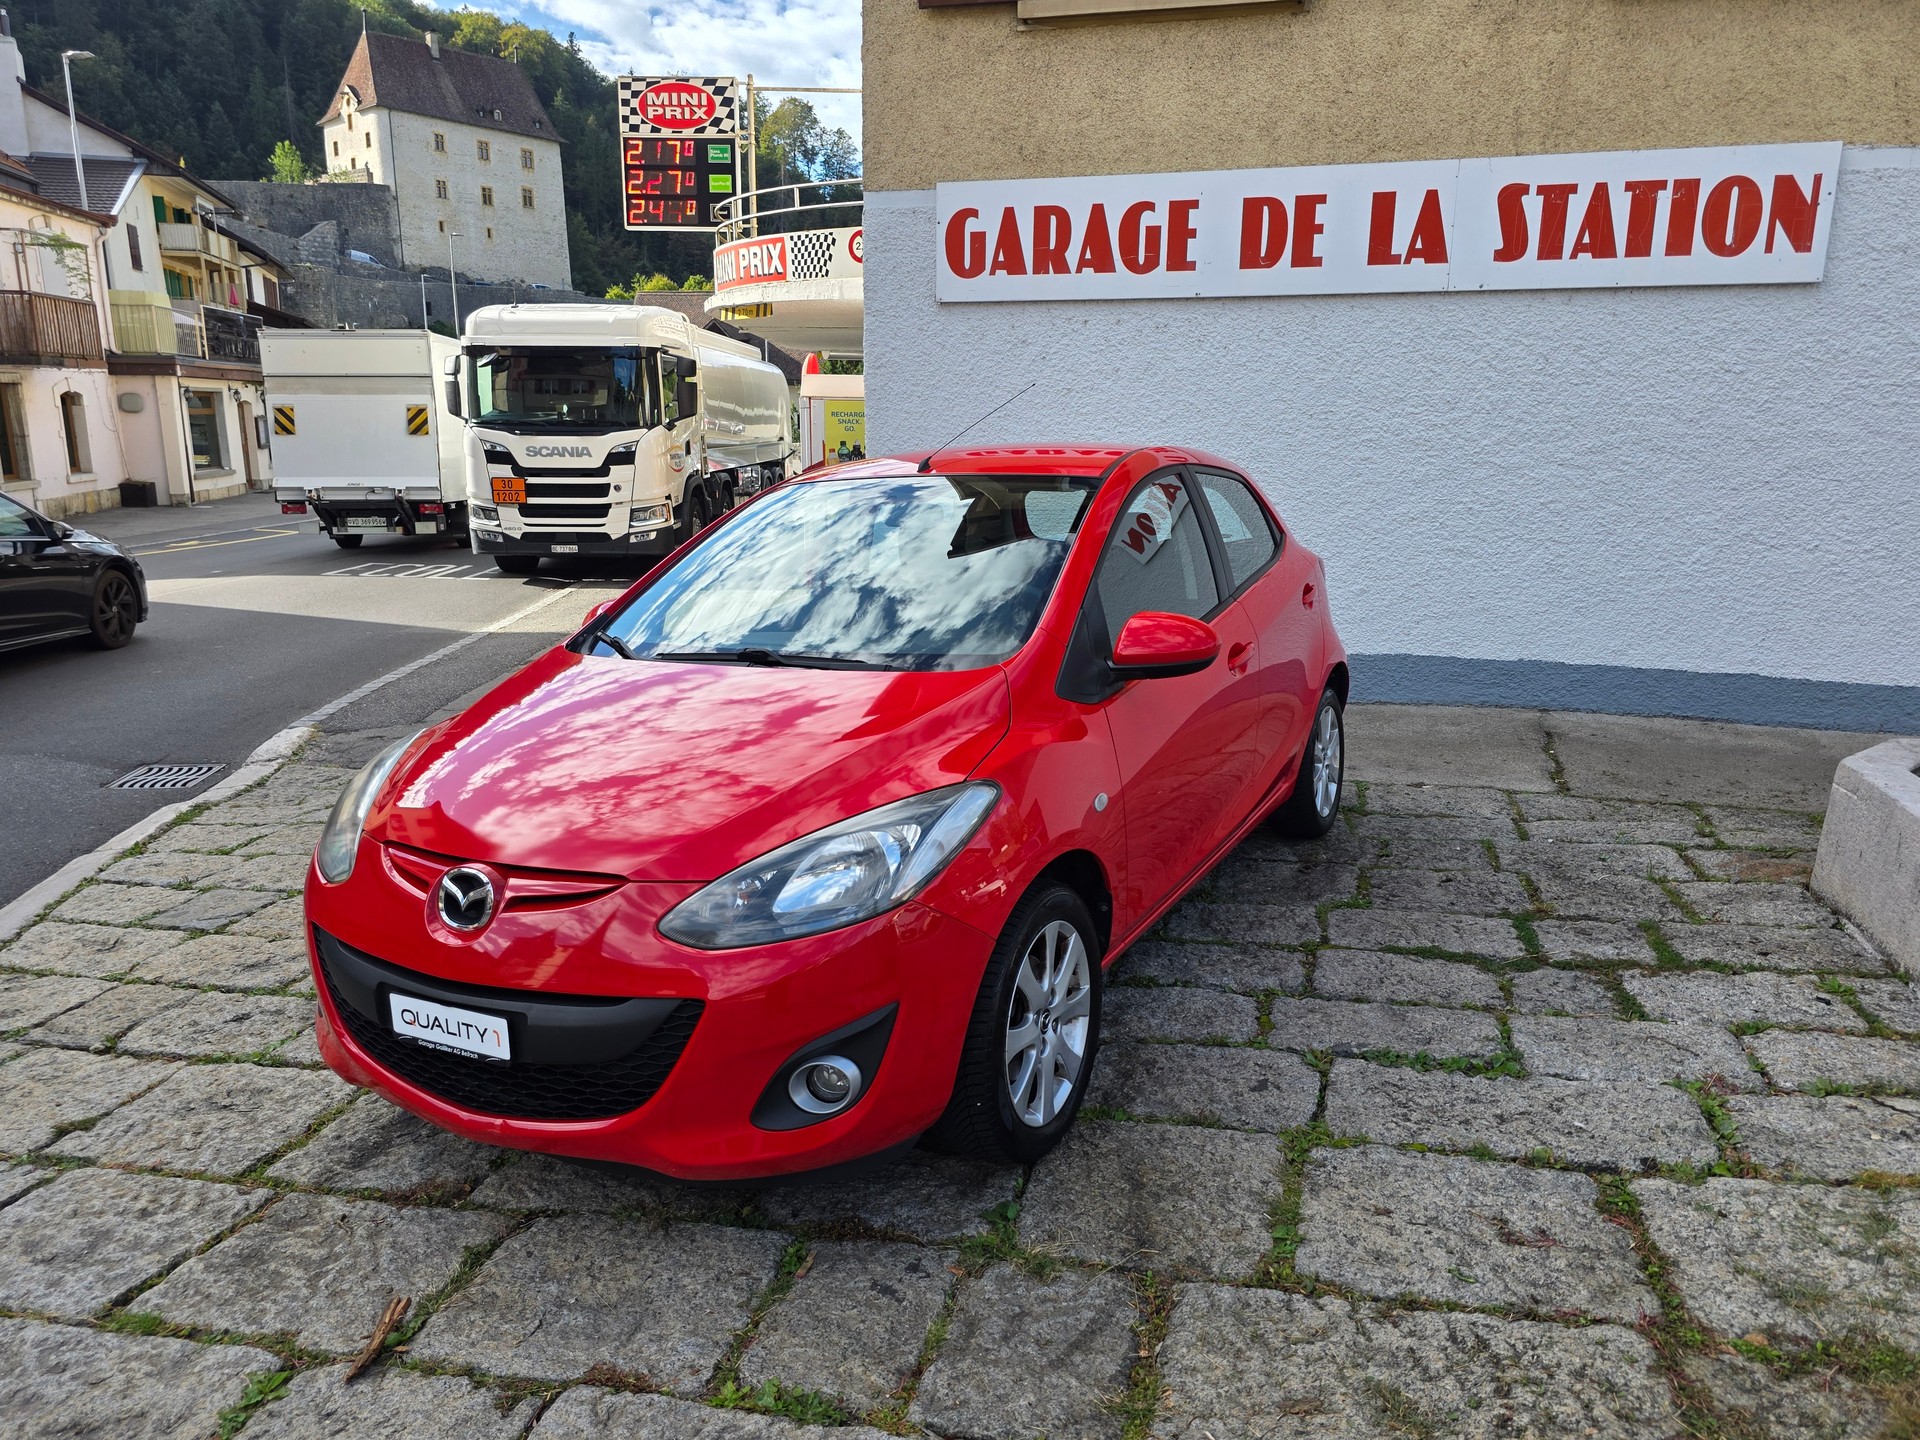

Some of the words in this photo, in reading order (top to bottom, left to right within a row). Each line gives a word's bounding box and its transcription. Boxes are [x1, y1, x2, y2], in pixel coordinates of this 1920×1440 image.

[646, 92, 708, 106] MINI
[646, 106, 709, 120] PRIX
[944, 198, 1200, 279] GARAGE
[1238, 194, 1328, 270] DE
[1366, 189, 1449, 266] LA
[1493, 173, 1823, 263] STATION
[715, 250, 737, 284] MINI
[738, 242, 784, 279] PRIX
[525, 445, 593, 458] SCANIA
[501, 479, 513, 489] 30
[496, 491, 520, 502] 1202
[401, 1008, 488, 1043] QUALITY
[418, 1039, 436, 1049] Garage
[453, 1048, 461, 1056] AG
